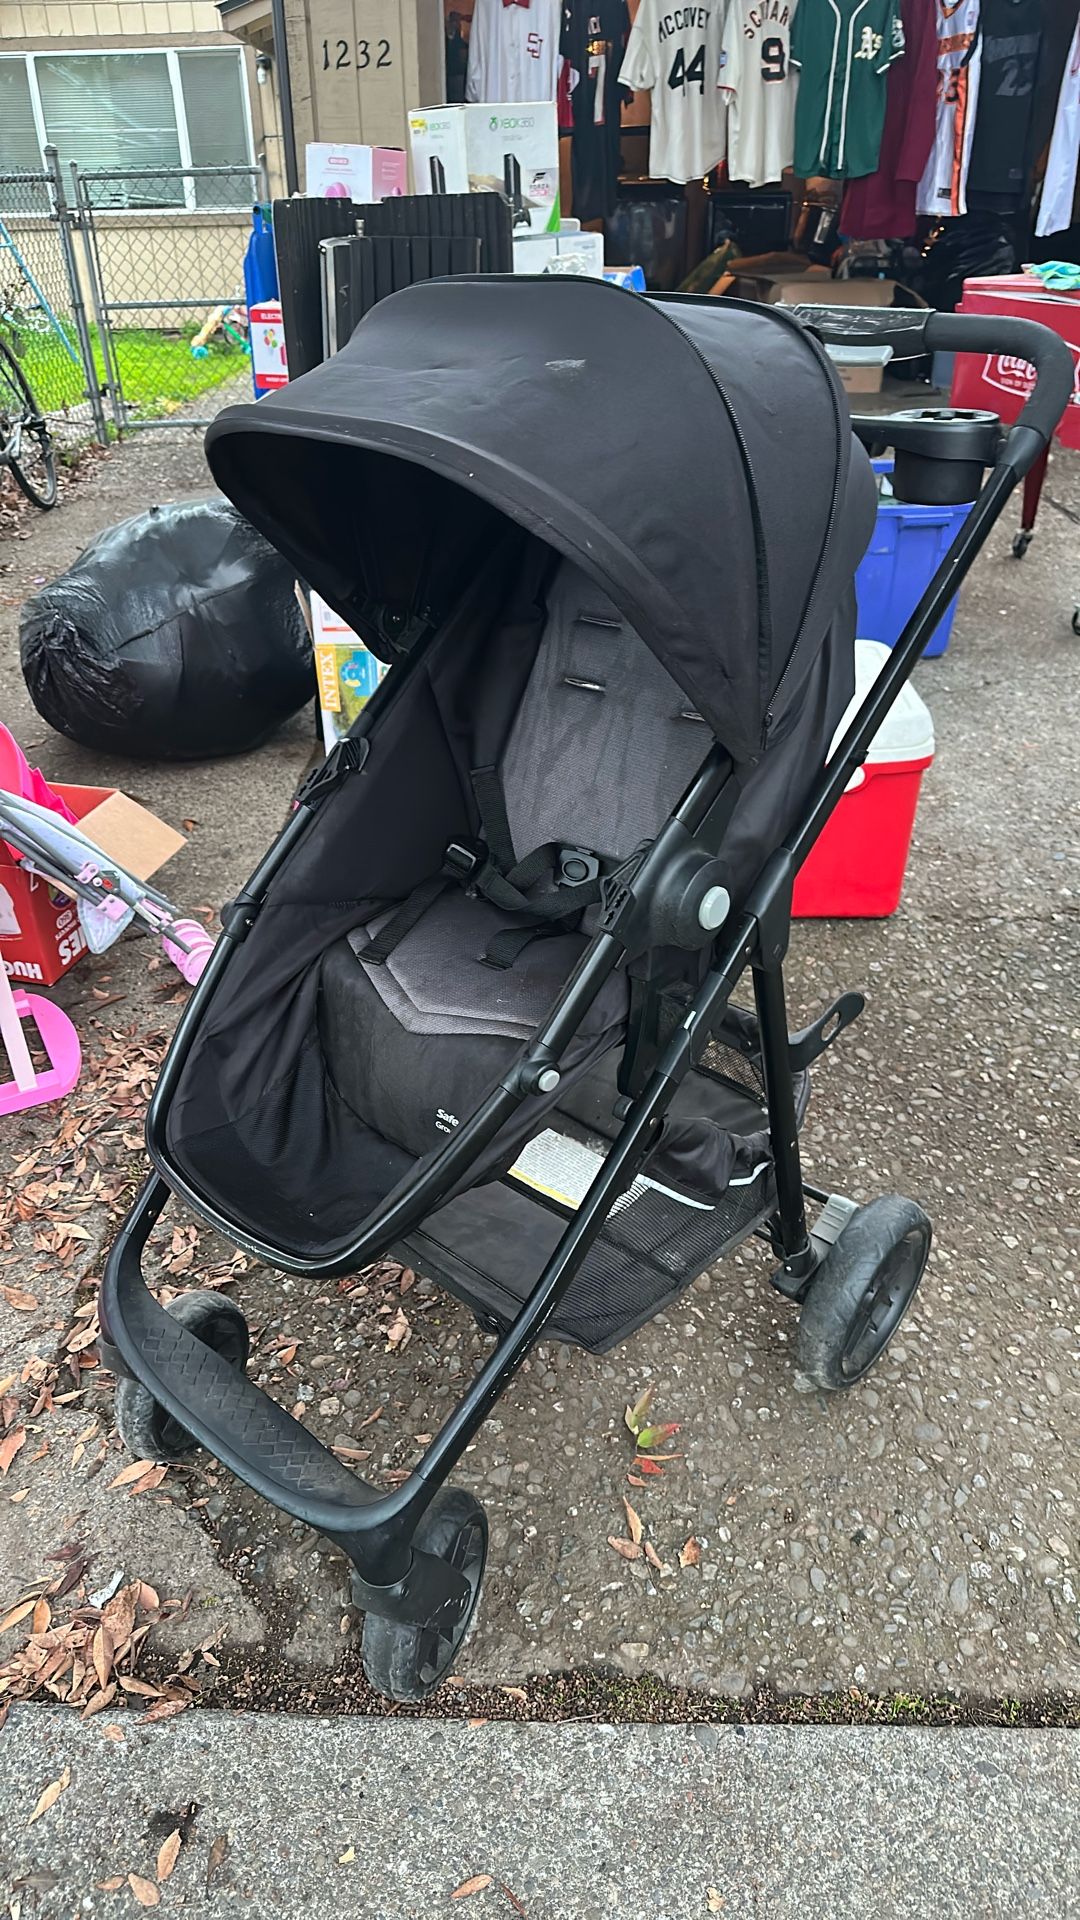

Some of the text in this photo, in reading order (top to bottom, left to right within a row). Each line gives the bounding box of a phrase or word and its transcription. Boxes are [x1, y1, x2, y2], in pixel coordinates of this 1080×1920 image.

[322, 39, 392, 71] 1232
[667, 44, 706, 97] 44
[761, 37, 786, 83] 9
[319, 652, 337, 709] INTEX
[436, 1108, 459, 1127] Safe
